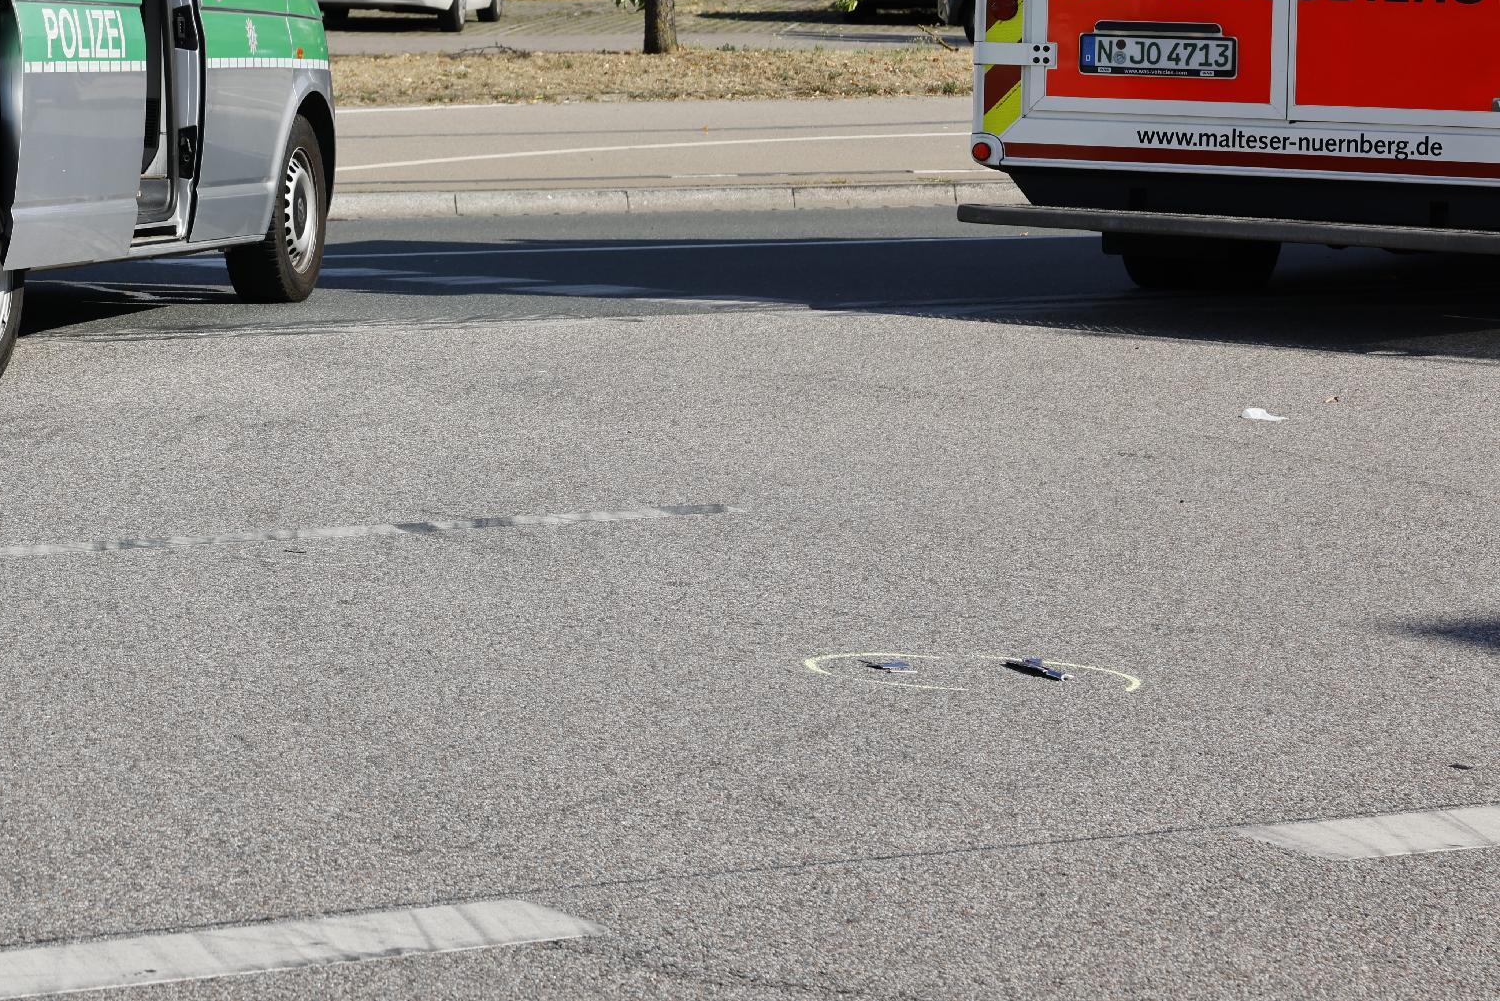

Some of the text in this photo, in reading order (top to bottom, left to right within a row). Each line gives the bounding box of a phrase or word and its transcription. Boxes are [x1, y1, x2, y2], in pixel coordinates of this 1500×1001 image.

[41, 7, 126, 59] POLIZEI
[1097, 39, 1230, 67] N JO 4713
[1136, 128, 1443, 160] www.malteser-nuernberg.de
